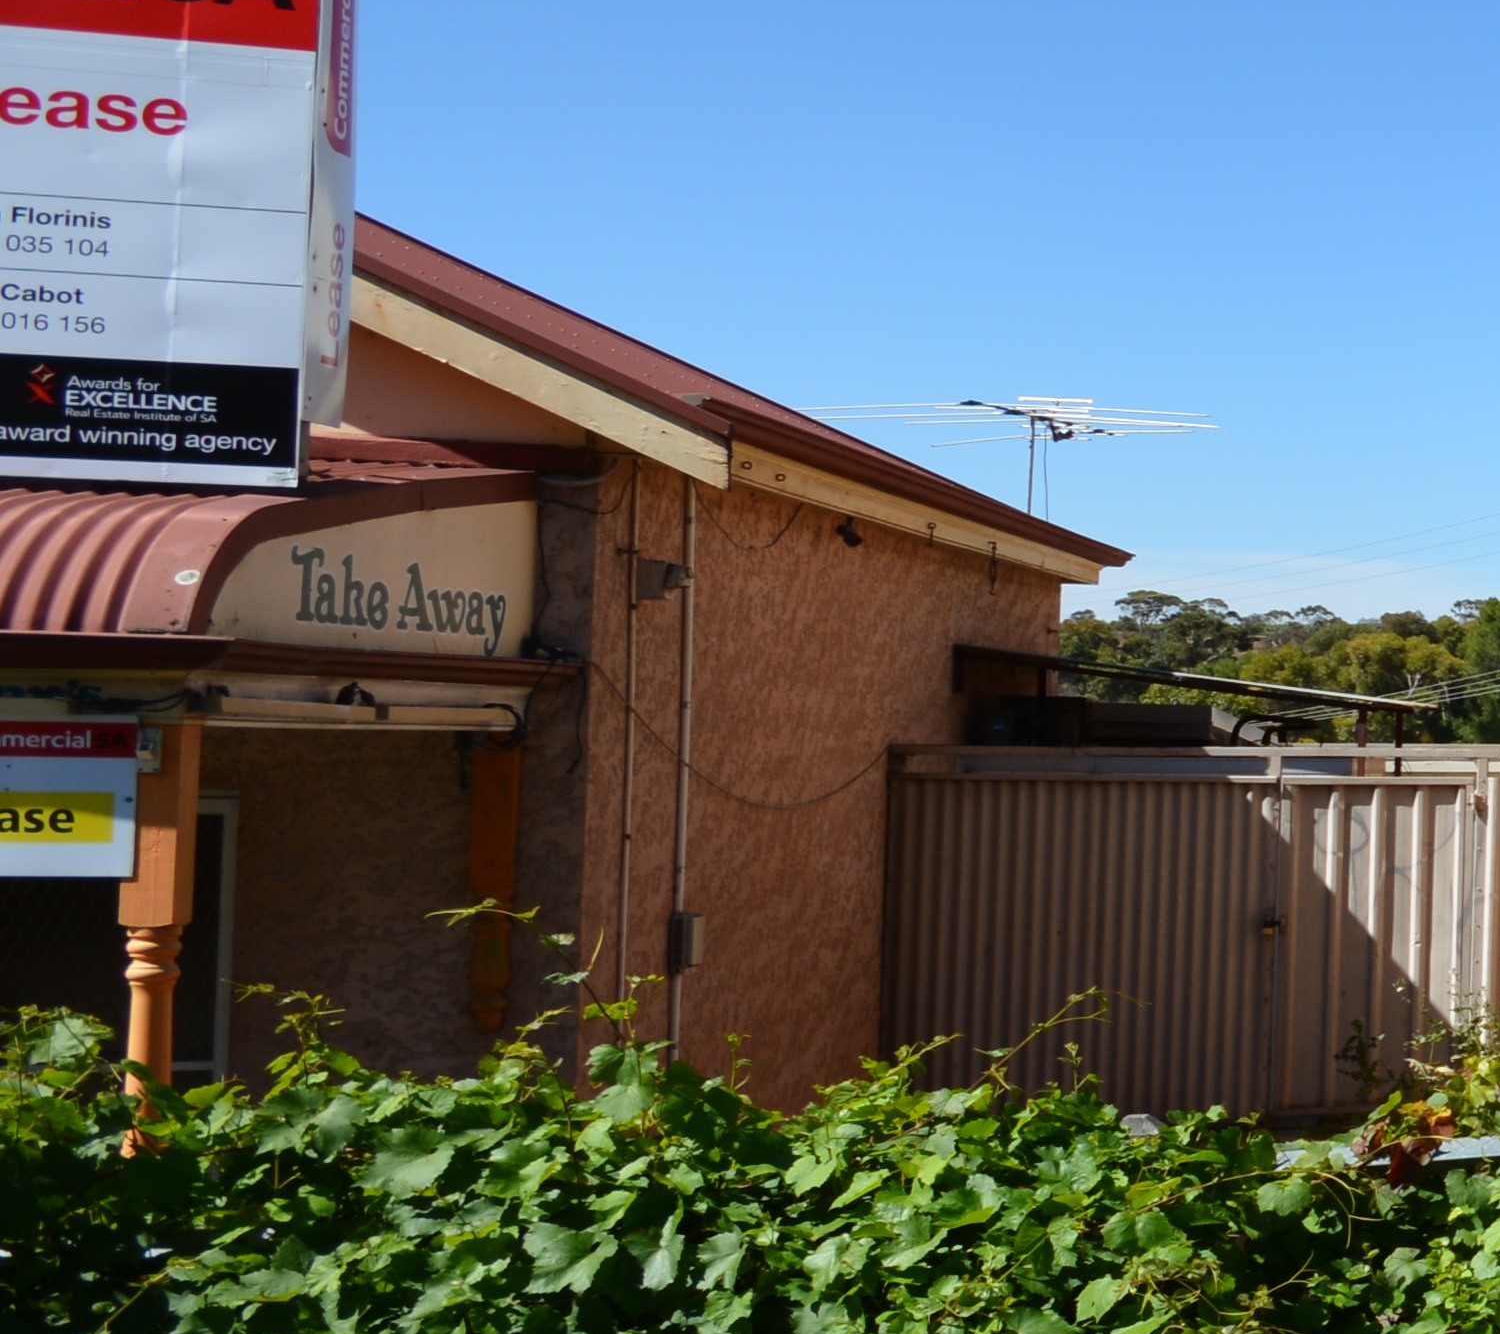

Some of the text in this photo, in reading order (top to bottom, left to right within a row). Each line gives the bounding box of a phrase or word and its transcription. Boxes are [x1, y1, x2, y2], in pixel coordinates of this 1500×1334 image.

[0, 87, 188, 137] ease
[11, 206, 111, 229] Florinis
[6, 234, 110, 257] 035 104
[0, 283, 84, 305] Cabot
[320, 222, 346, 369] Lease
[1, 312, 106, 334] 016 156
[67, 375, 160, 392] Awards for
[65, 389, 218, 413] EXCELLENCE
[65, 407, 217, 423] Real Estate Institute of SA
[79, 426, 177, 452] winning
[185, 433, 277, 456] agency
[291, 545, 507, 657] Take Away
[0, 730, 91, 749] mercial
[0, 806, 76, 834] ase
